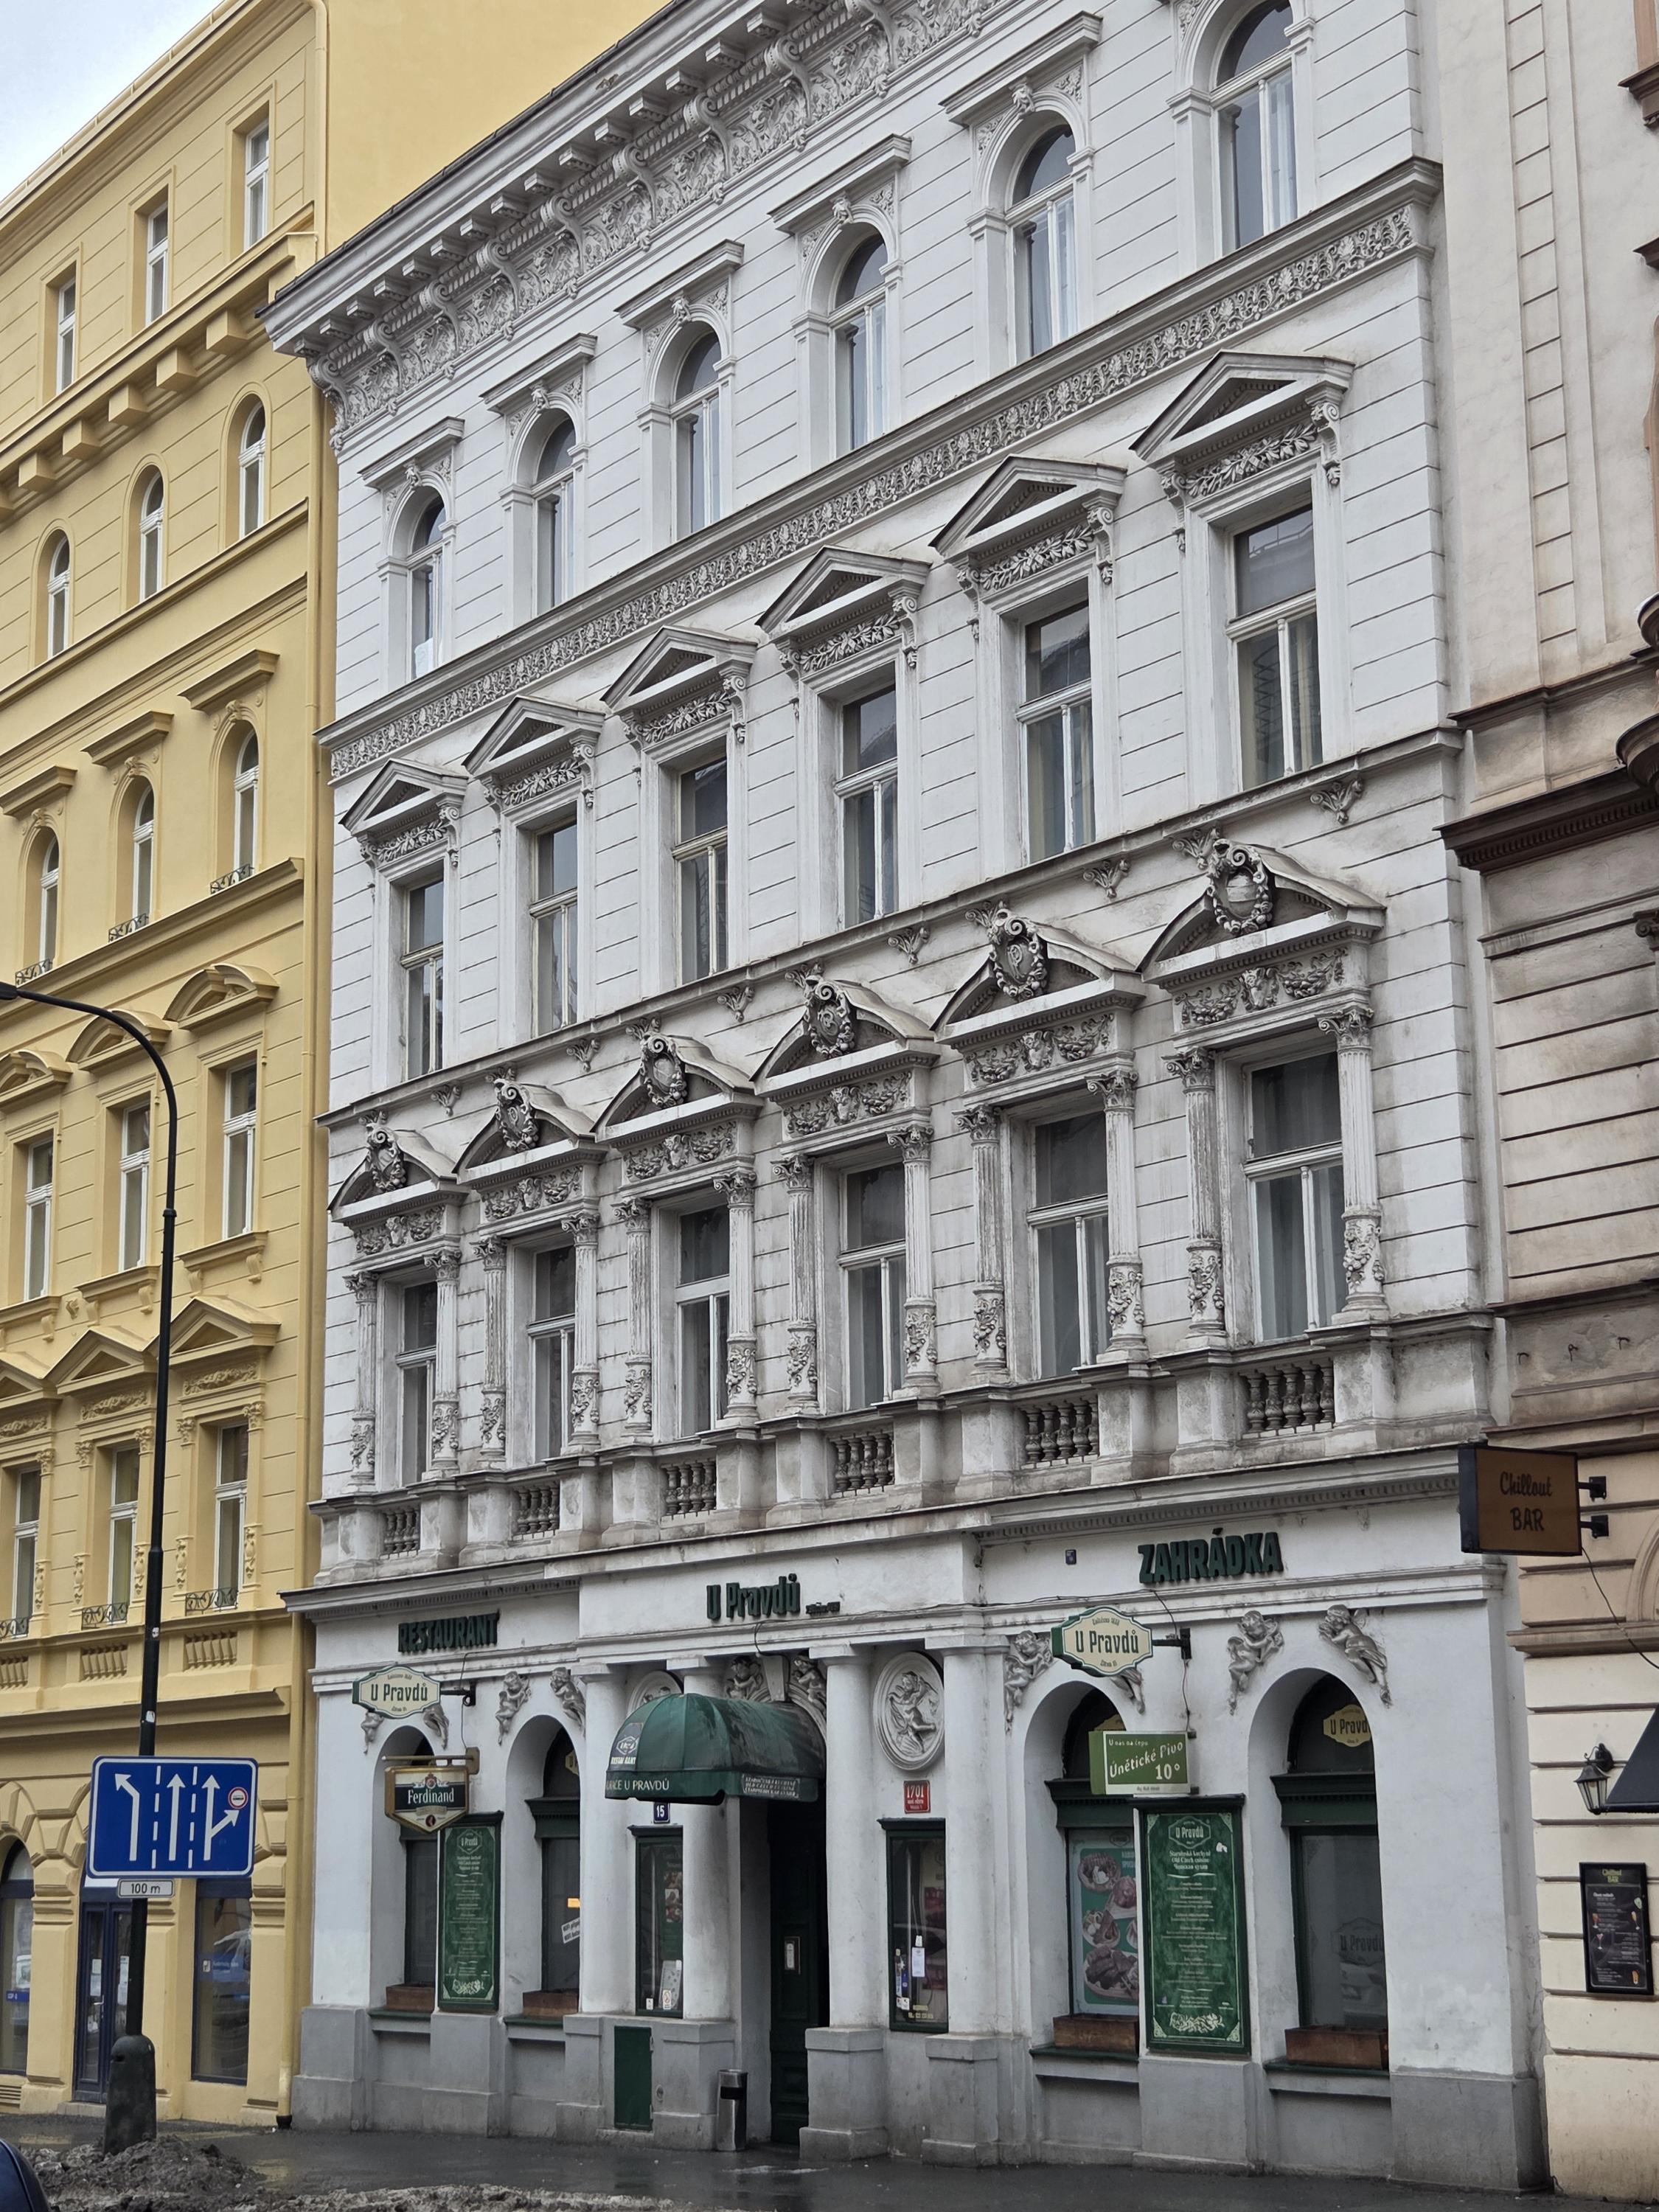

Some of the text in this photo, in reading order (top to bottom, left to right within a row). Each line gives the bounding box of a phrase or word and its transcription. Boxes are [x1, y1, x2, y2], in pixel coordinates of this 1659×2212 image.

[1500, 1471, 1553, 1497] Chillout
[1510, 1507, 1545, 1531] BAR
[1138, 1528, 1284, 1583] ZAHRÁDKA
[706, 1573, 800, 1619] U Pravdů
[398, 1613, 498, 1652] RESTAURANT
[1075, 1630, 1139, 1654] U Pravdů
[371, 1683, 428, 1702] U Pravdů
[1330, 1719, 1337, 1735] U
[1110, 1742, 1183, 1778] Únětické Pivo
[407, 1788, 455, 1804] Ferdinand
[625, 1780, 630, 1791] U
[906, 1784, 925, 1798] 1701
[656, 1805, 665, 1818] 15
[131, 1883, 160, 1893] 100 m
